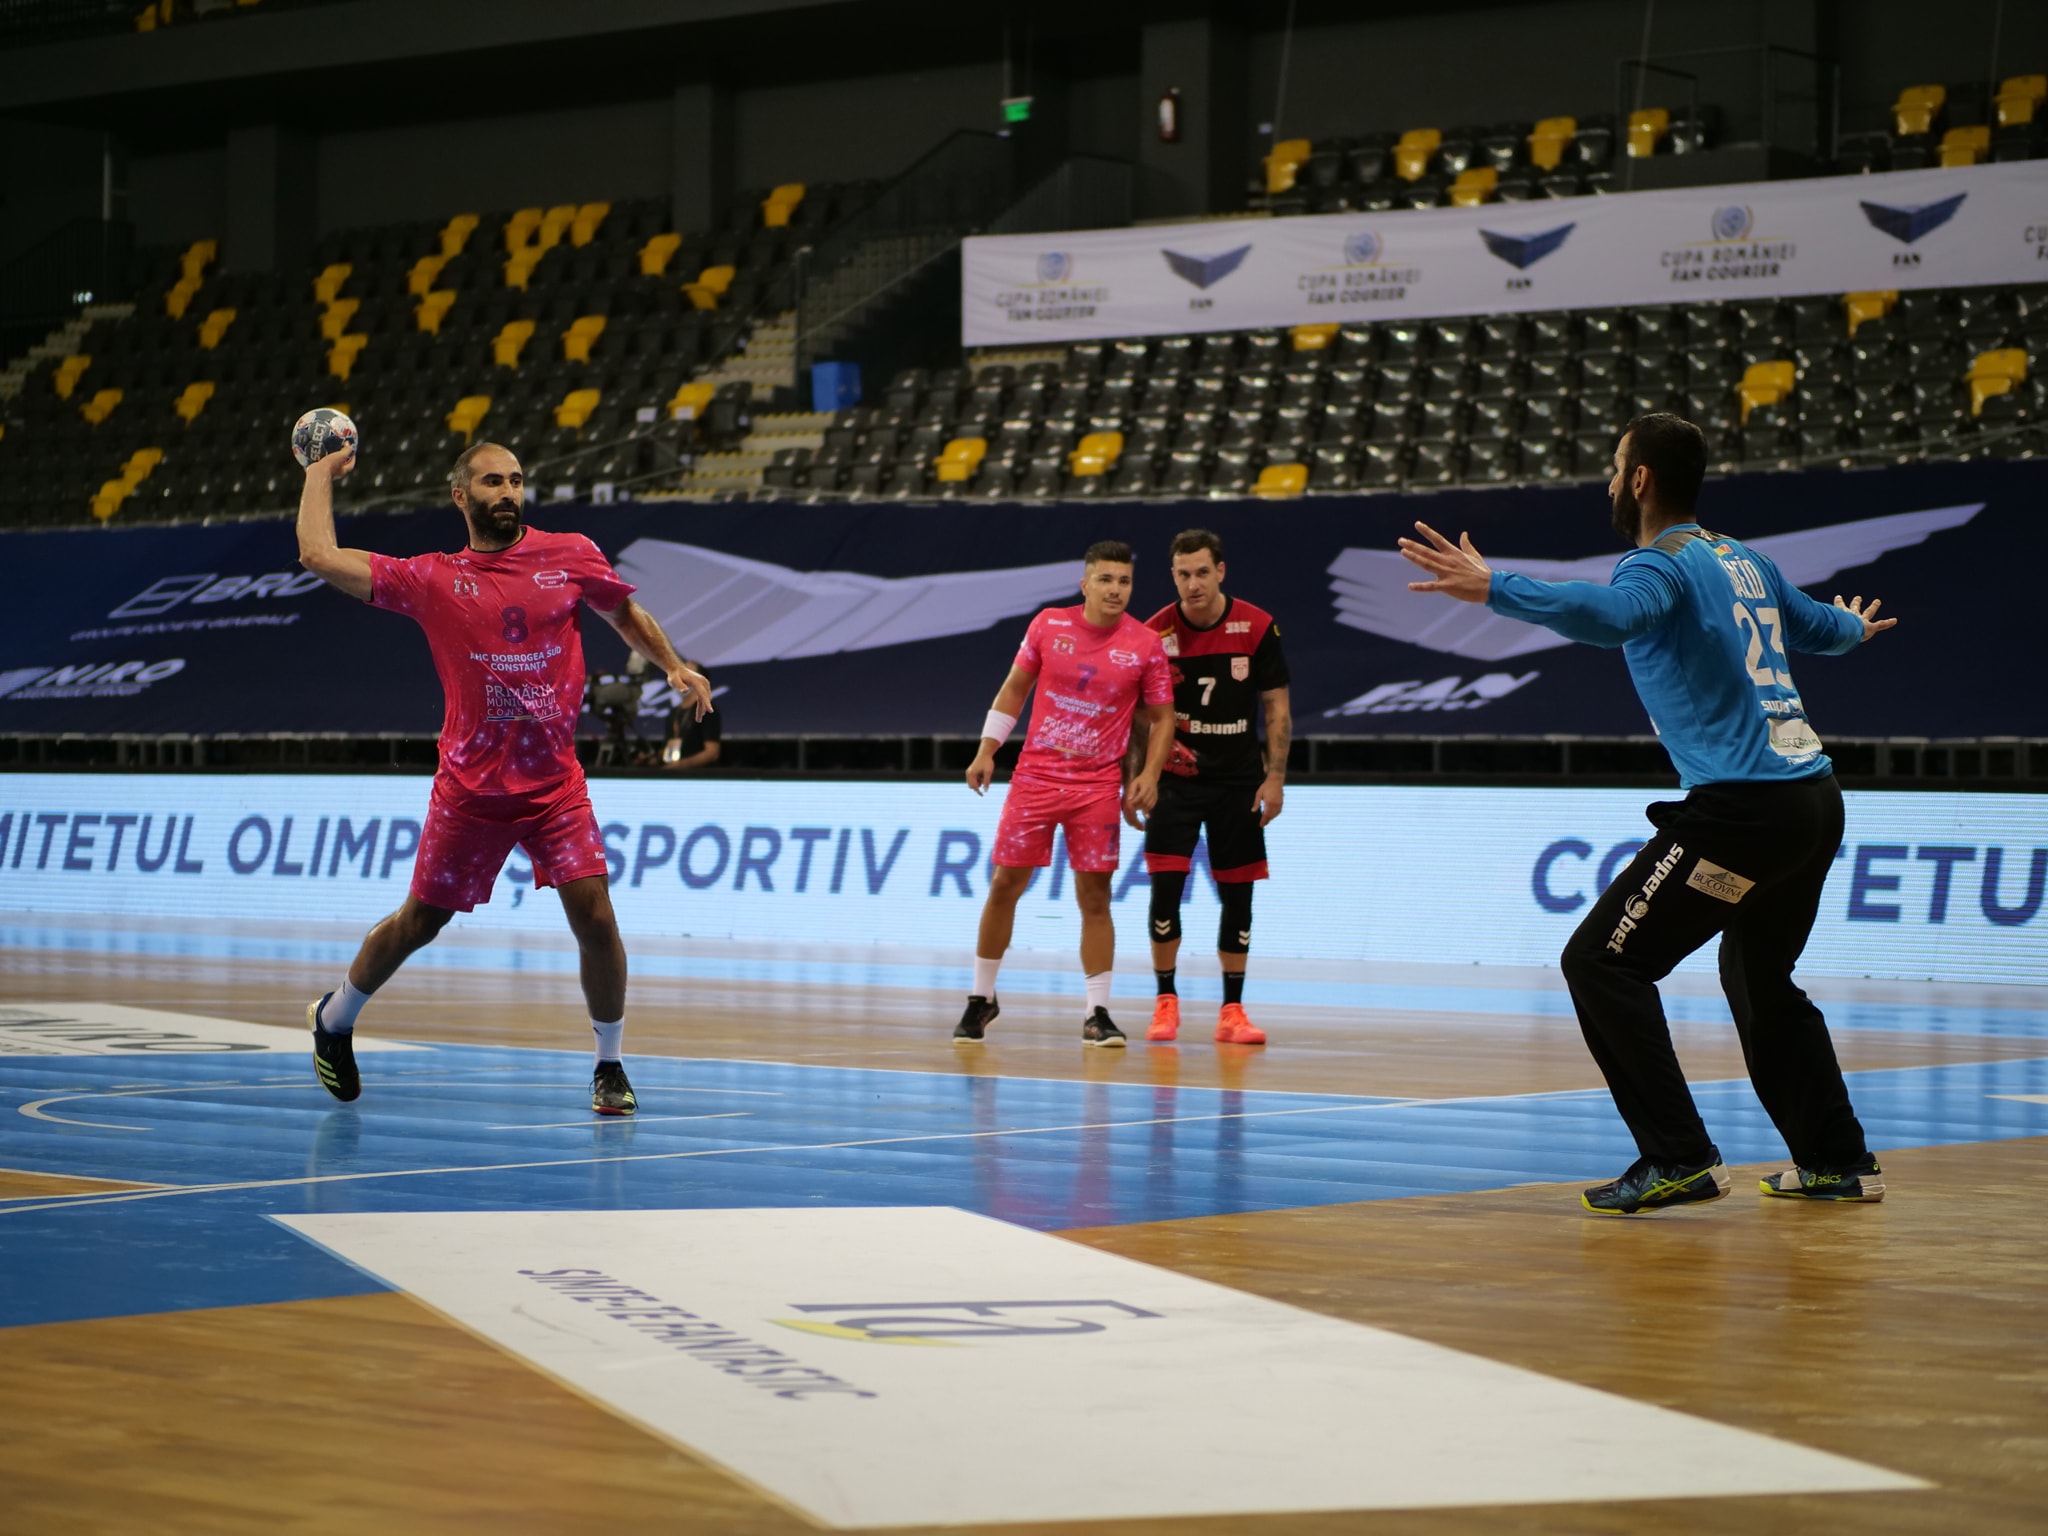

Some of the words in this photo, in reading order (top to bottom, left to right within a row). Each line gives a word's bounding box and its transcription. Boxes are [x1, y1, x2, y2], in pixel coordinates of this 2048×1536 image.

[1661, 250, 1704, 268] CUPA
[1671, 268, 1702, 283] FAN
[1707, 263, 1780, 281] COURIER
[1893, 253, 1921, 265] FAN
[1298, 275, 1337, 291] CUPA
[1506, 277, 1532, 290] FAN
[310, 421, 328, 461] SELECT
[191, 571, 327, 603] BRD
[502, 606, 529, 644] 8
[469, 652, 489, 661] AHC
[491, 652, 545, 663] DOBROGEA
[546, 646, 562, 658] SUD
[1733, 601, 1793, 690] 23
[34, 658, 186, 686] NIRO
[1076, 663, 1099, 693] 7
[1197, 677, 1217, 707] 7
[1189, 719, 1248, 735] Baumit
[601, 822, 912, 896] SPORTIV
[1640, 843, 1684, 901] super
[1693, 872, 1742, 898] BUCOVINA
[1606, 915, 1637, 954] bet
[1816, 1173, 1842, 1186] asics
